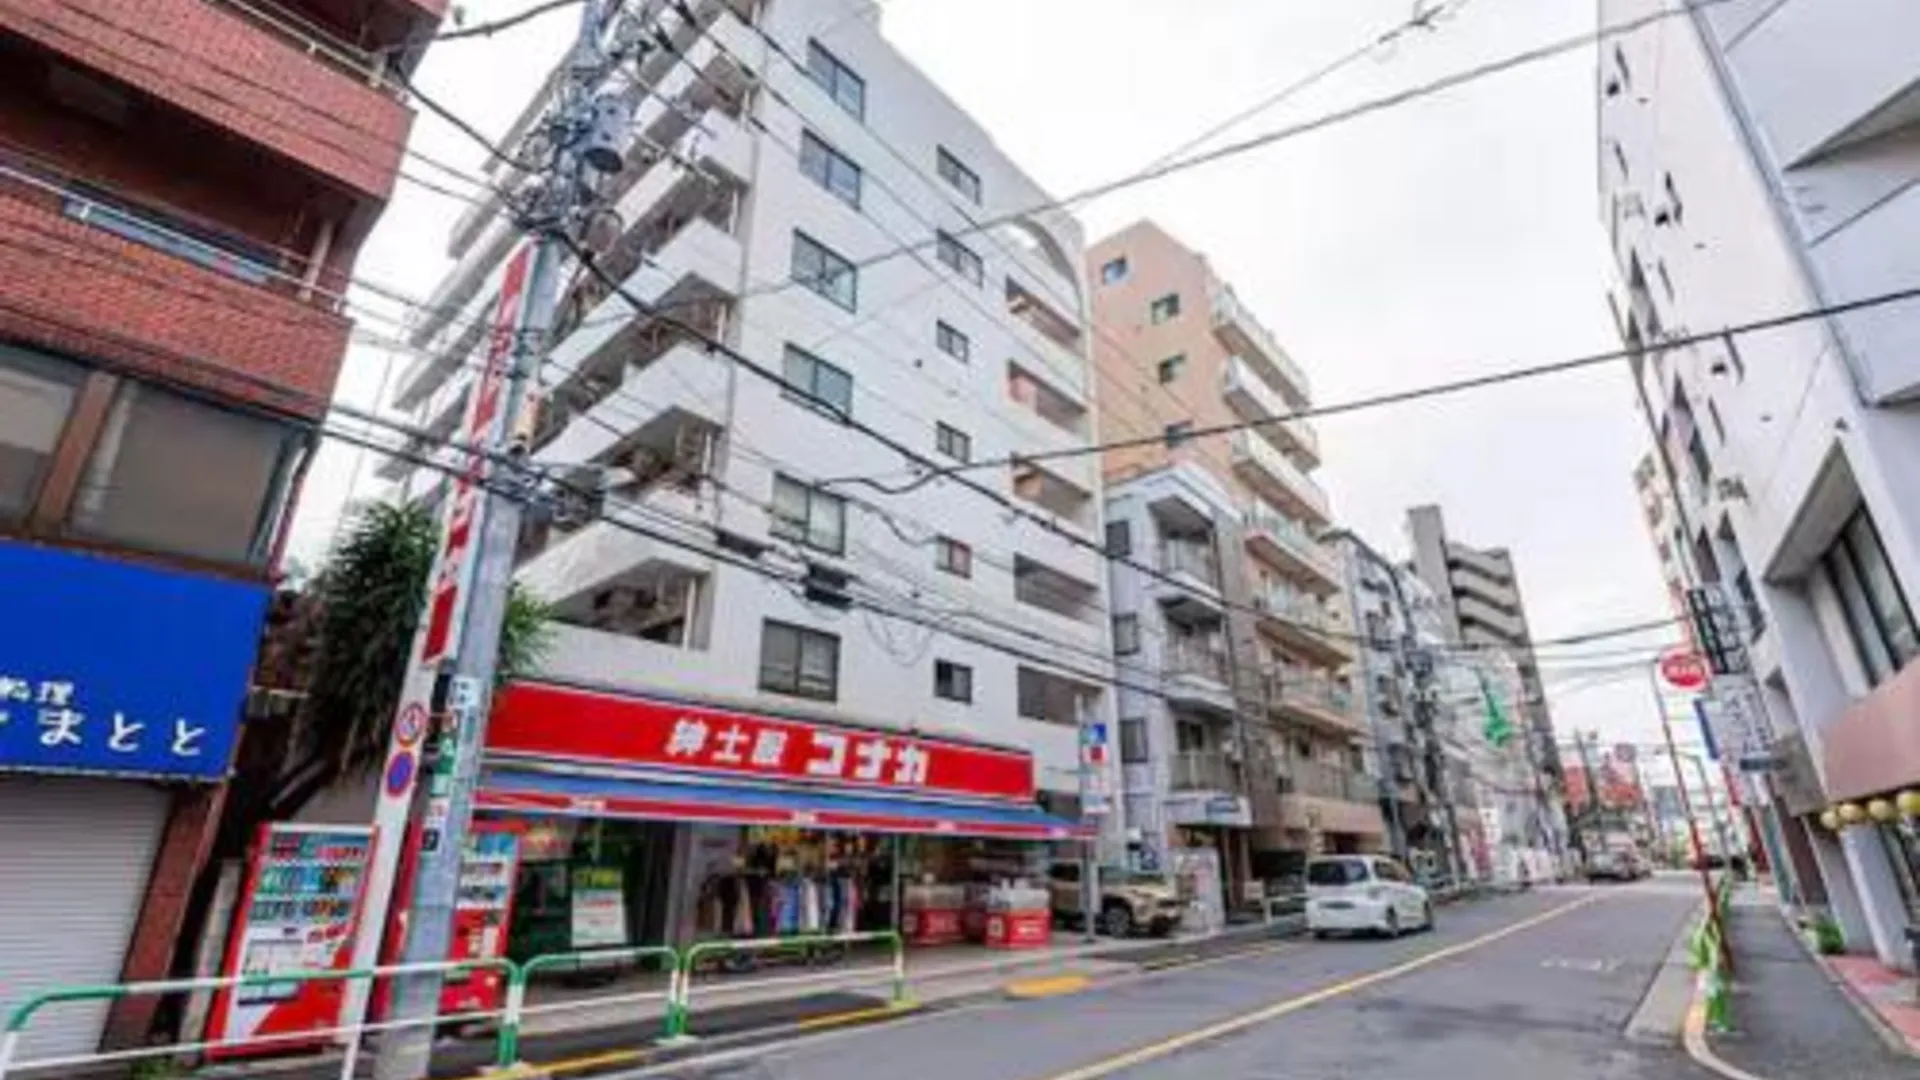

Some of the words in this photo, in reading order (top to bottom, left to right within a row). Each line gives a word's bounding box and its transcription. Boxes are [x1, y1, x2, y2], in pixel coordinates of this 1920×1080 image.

[0, 708, 206, 757] まとと
[806, 731, 931, 785] コナカ
